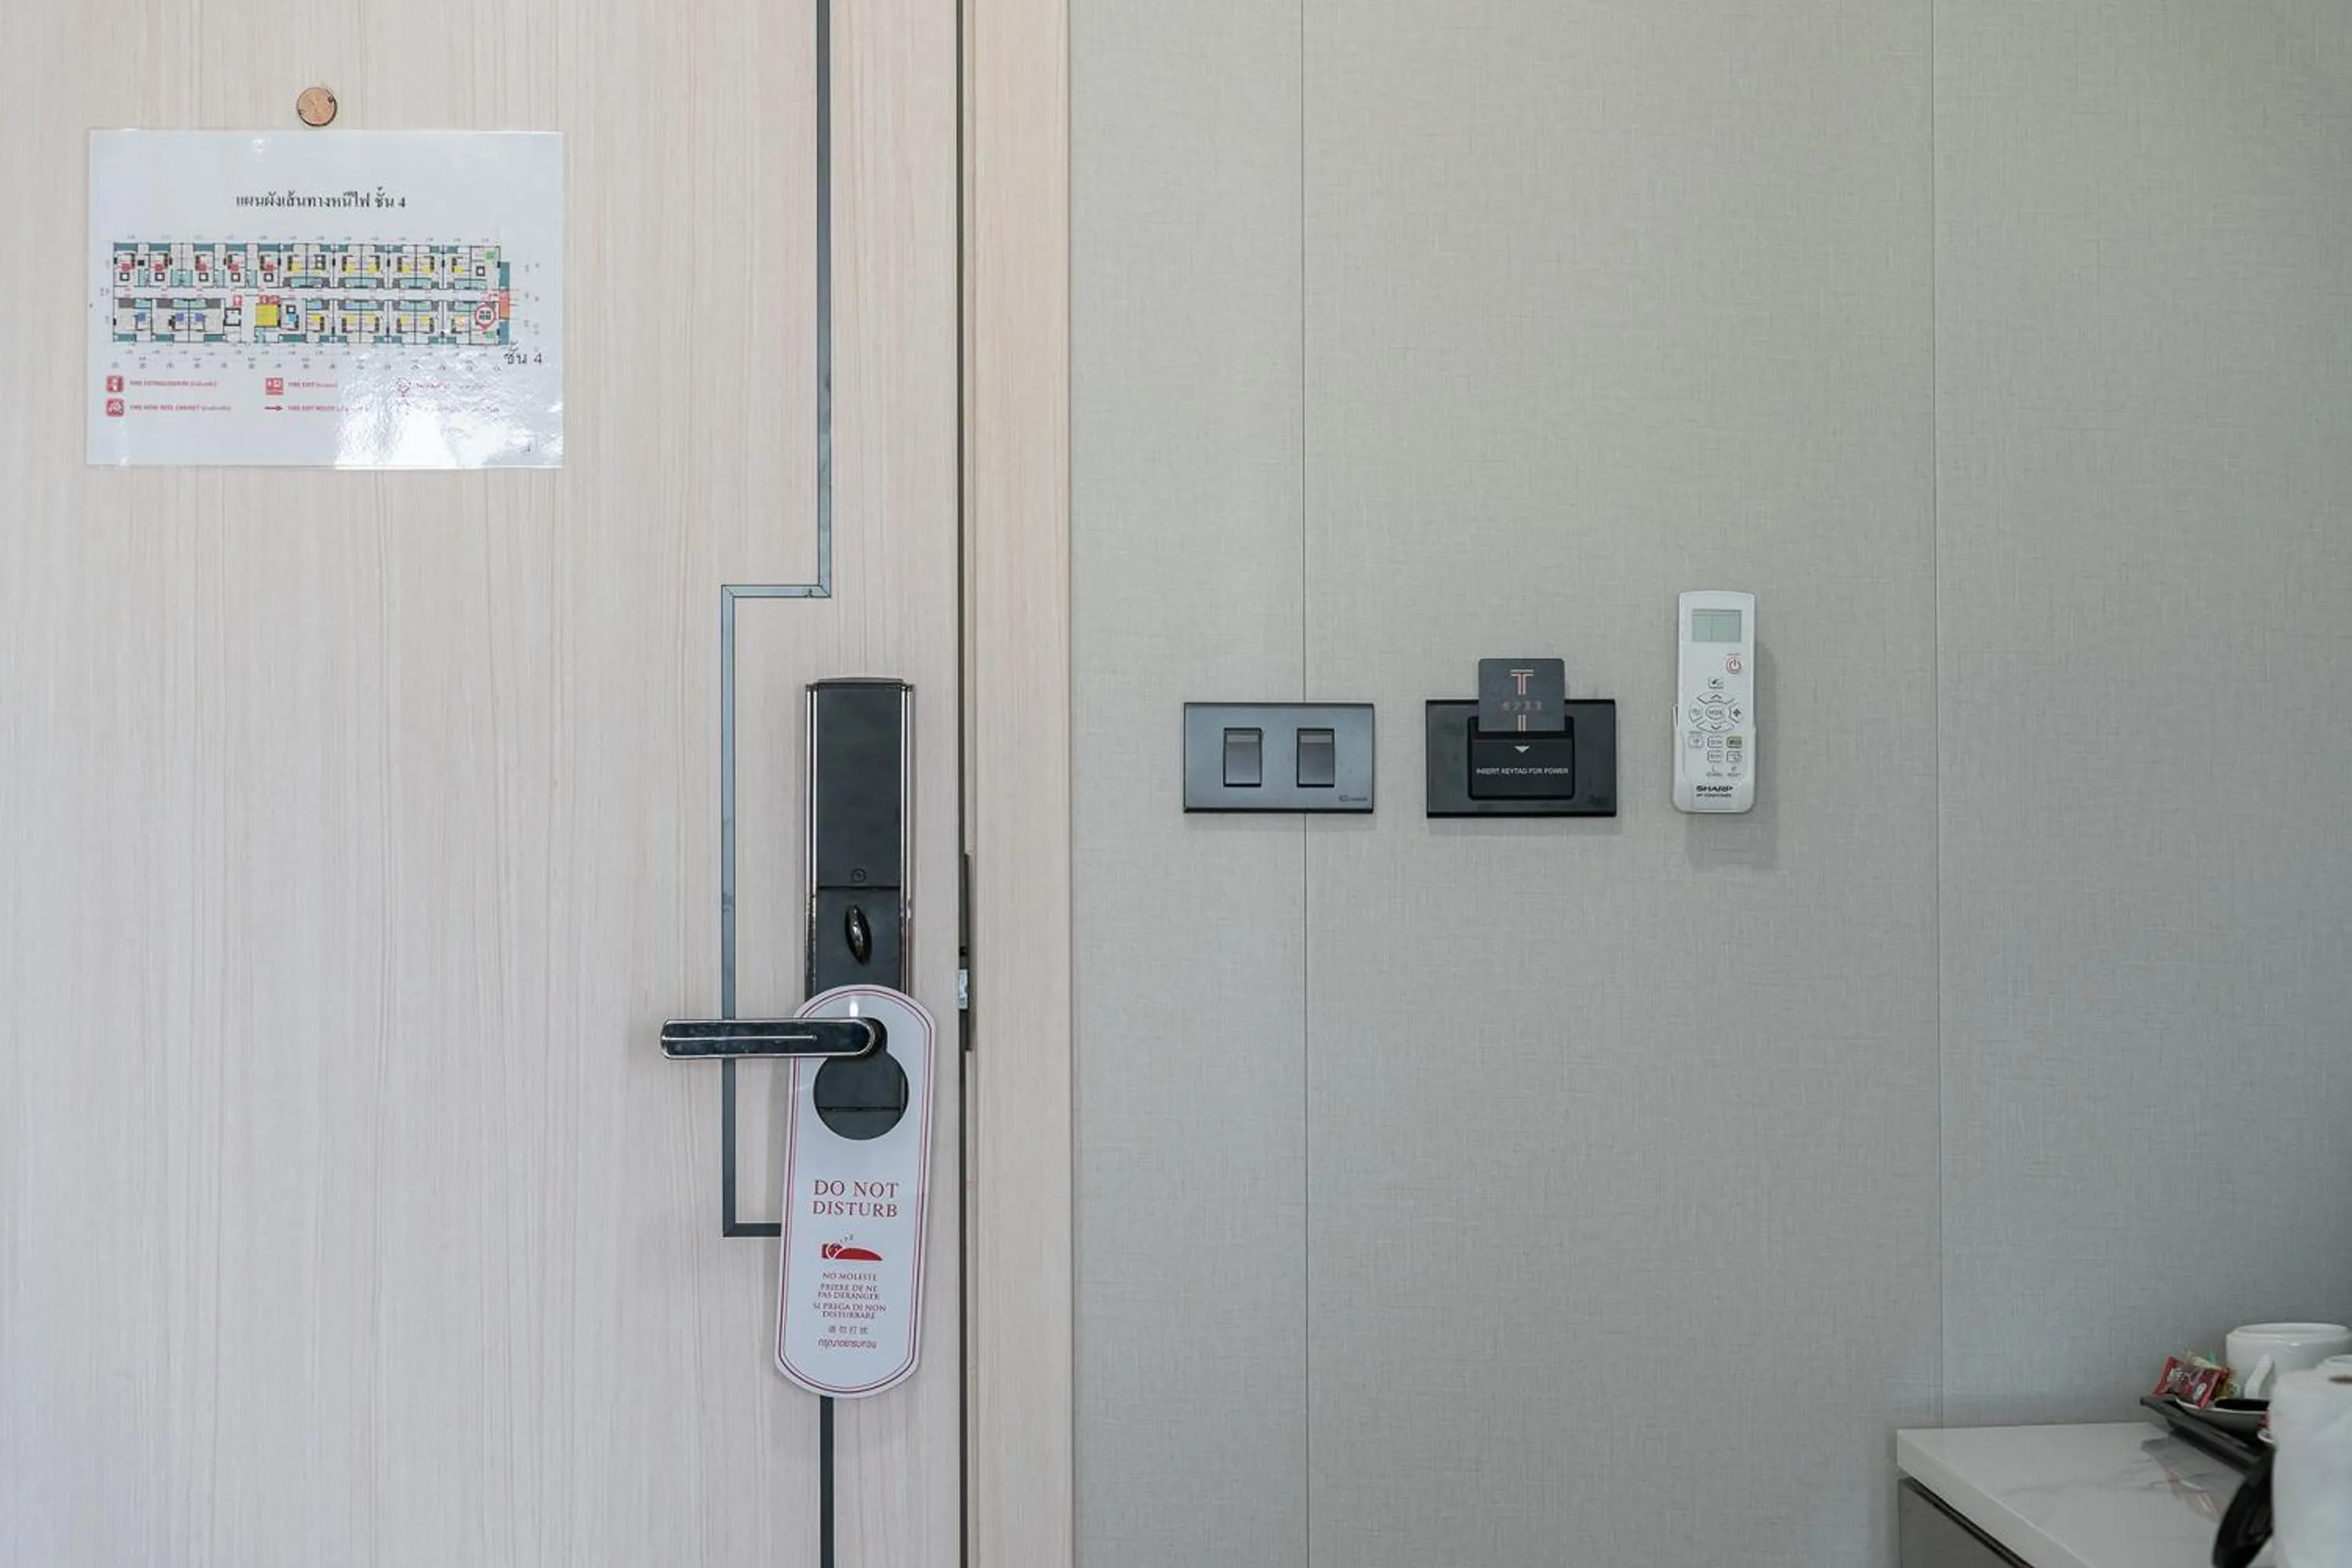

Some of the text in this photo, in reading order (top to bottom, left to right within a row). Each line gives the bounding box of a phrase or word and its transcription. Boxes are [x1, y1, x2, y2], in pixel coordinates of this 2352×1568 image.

[375, 186, 394, 208] ชั้น
[397, 197, 406, 208] 4
[504, 341, 528, 365] ชั้น
[534, 352, 543, 365] 4
[813, 1179, 900, 1199] DO NOT
[812, 1200, 898, 1218] DISTURB
[838, 1272, 877, 1281] MOLESTE
[822, 1310, 876, 1319] DISTURBARE
